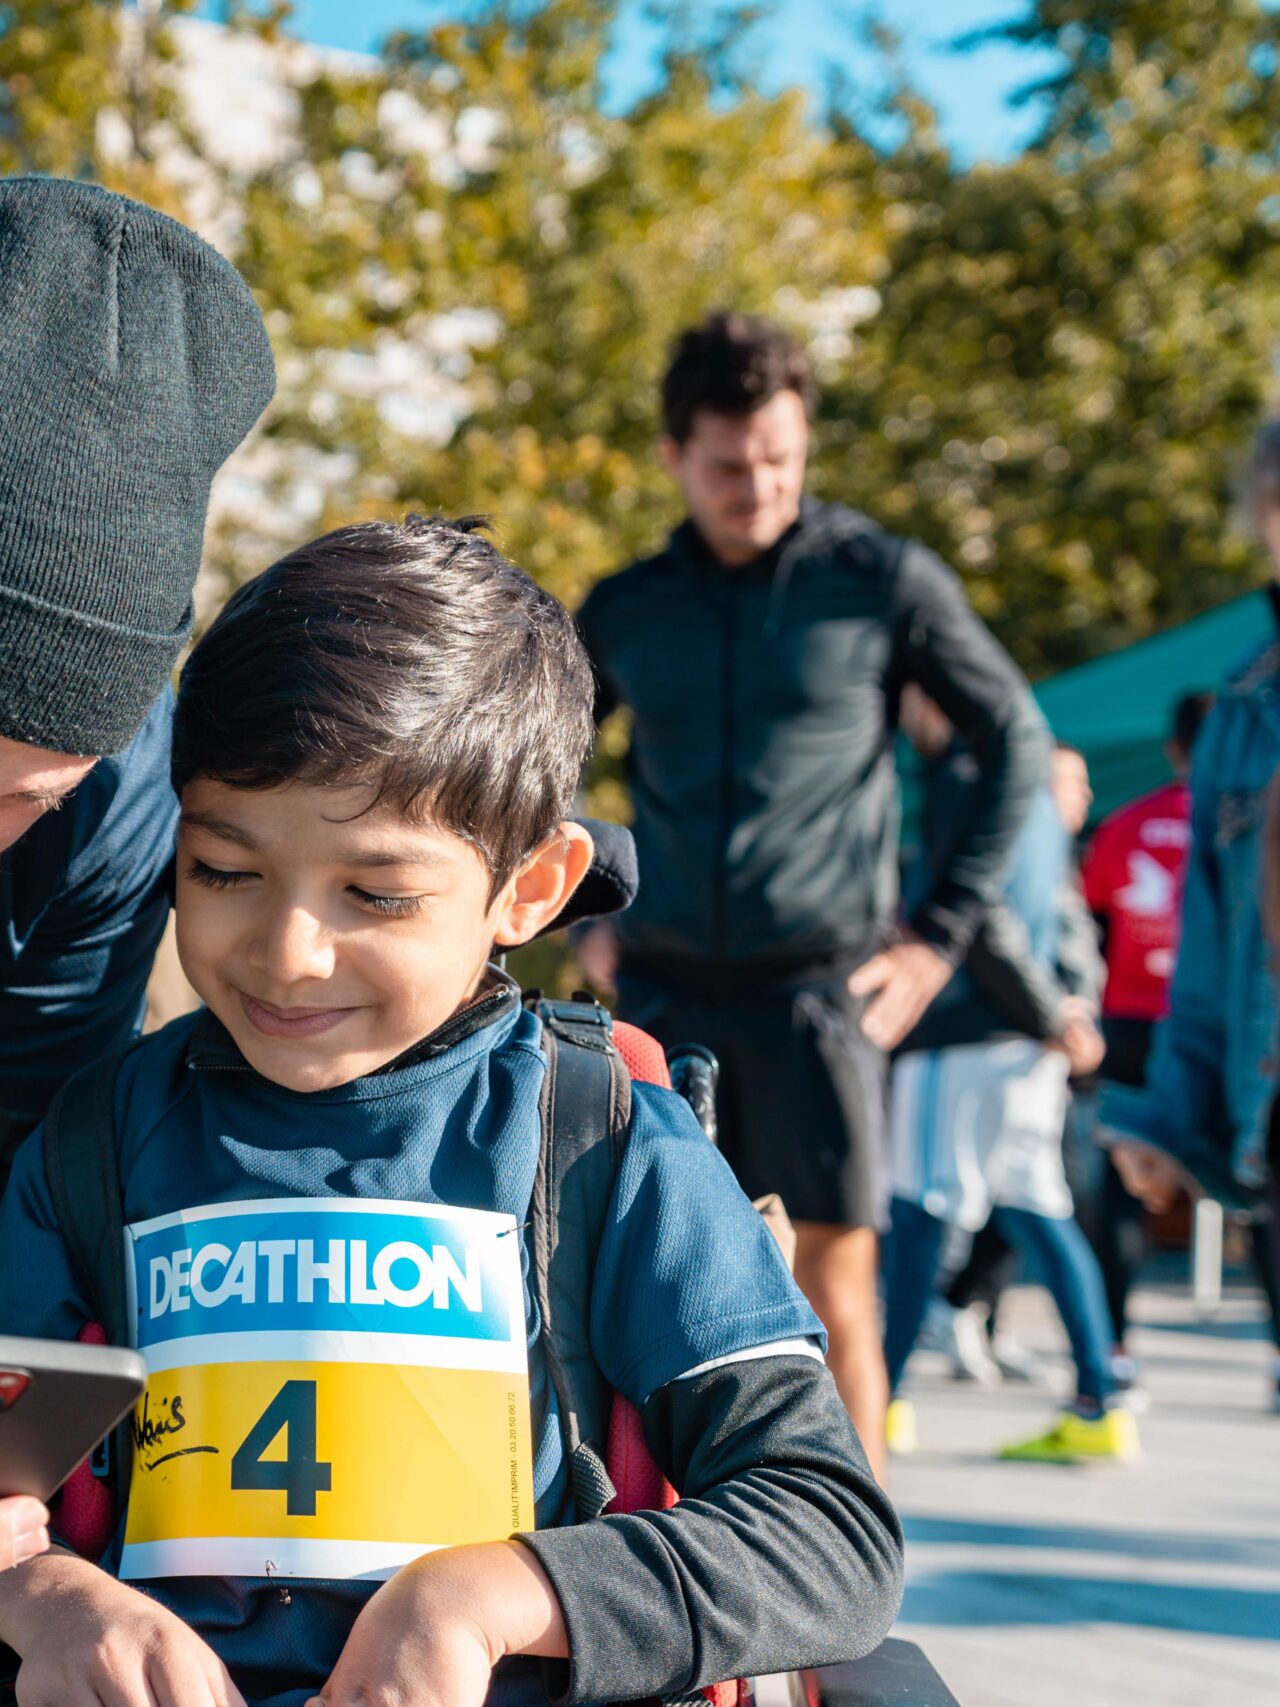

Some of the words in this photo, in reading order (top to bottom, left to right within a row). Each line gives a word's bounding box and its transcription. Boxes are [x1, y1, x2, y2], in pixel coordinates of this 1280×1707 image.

[149, 1239, 483, 1320] DECATHLON
[231, 1379, 332, 1517] 4
[510, 1459, 520, 1529] QUALIT'IMPRIM
